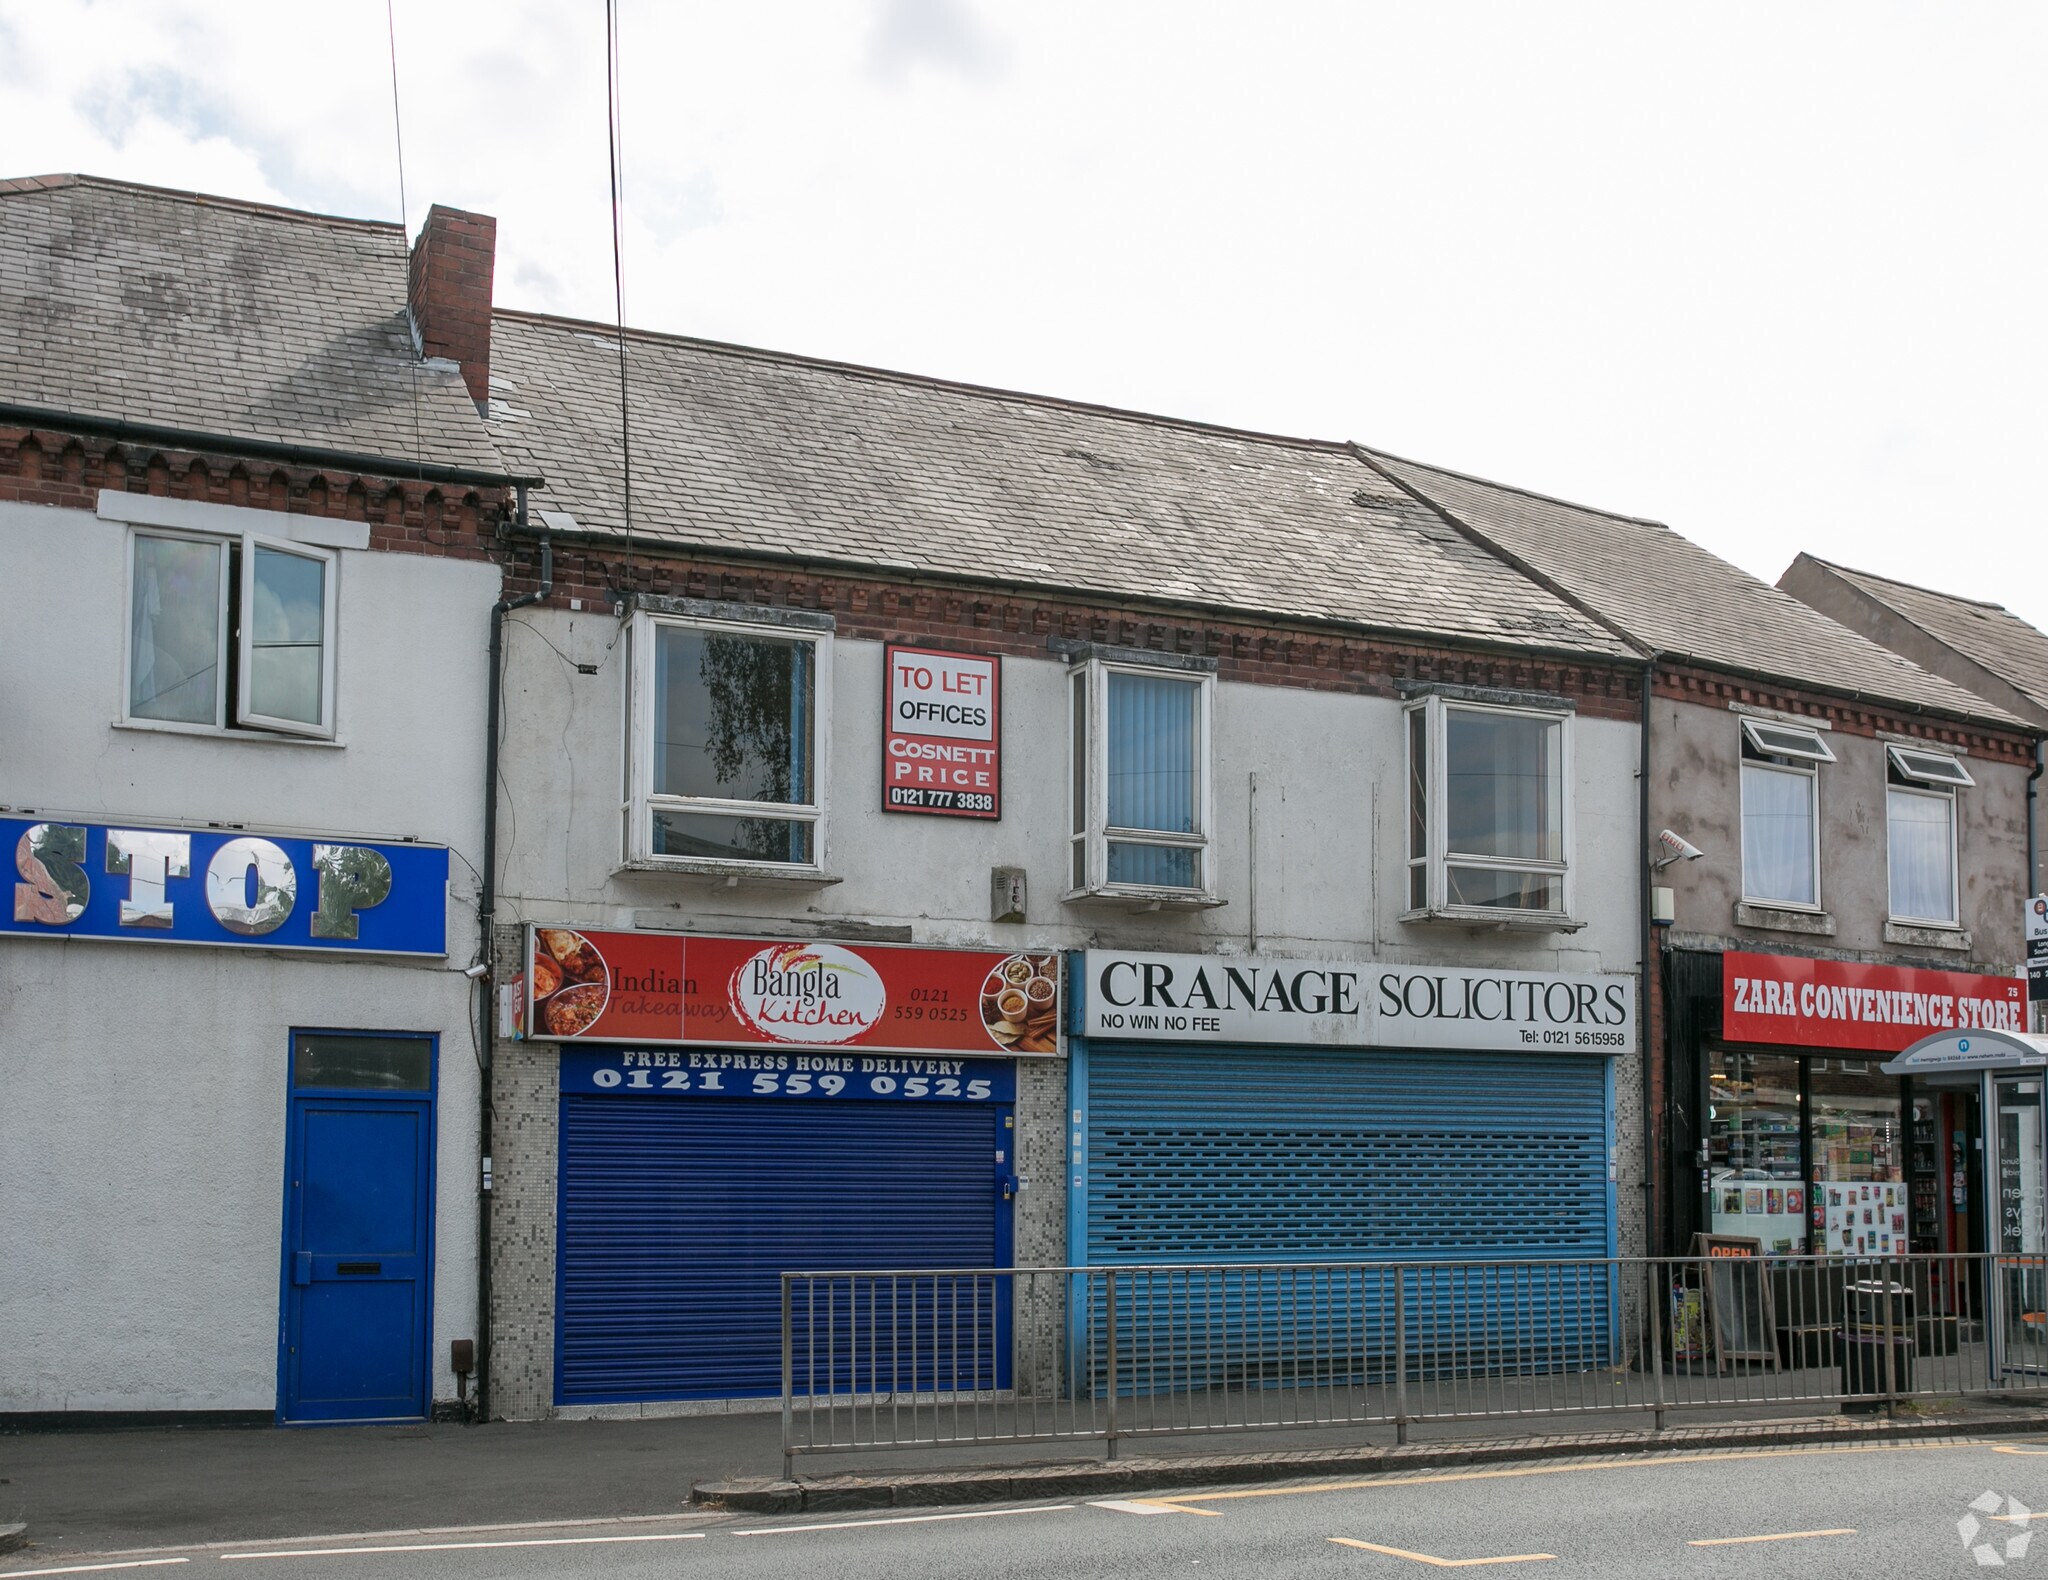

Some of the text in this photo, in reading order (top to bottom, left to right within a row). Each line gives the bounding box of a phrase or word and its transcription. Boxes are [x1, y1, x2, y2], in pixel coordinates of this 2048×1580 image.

[898, 666, 987, 695] TO LET
[900, 700, 986, 726] OFFICES
[888, 738, 995, 764] COSNETT
[895, 762, 990, 787] PRICE
[892, 788, 993, 811] 0121 777 3838
[14, 823, 392, 940] STOP
[2034, 928, 2047, 936] Bus
[612, 967, 698, 994] Indian
[753, 959, 842, 1006] Bangla
[1100, 961, 1626, 1026] CRANAGE SOLICITORS
[2008, 986, 2018, 998] 75
[910, 988, 949, 1003] 0121
[1734, 977, 2021, 1032] ZARA CONVENIENCE STORE
[609, 995, 730, 1023] Takeaway
[758, 999, 869, 1026] Kitchen
[895, 1007, 968, 1022] 559 0525
[1101, 1013, 1220, 1032] NO WIN NO FEE
[1519, 1028, 1625, 1047] Tel: 0121 5615958
[623, 1051, 964, 1076] FREE EXPRESS HOME DELIVERY
[592, 1068, 991, 1099] 0121 559 0525
